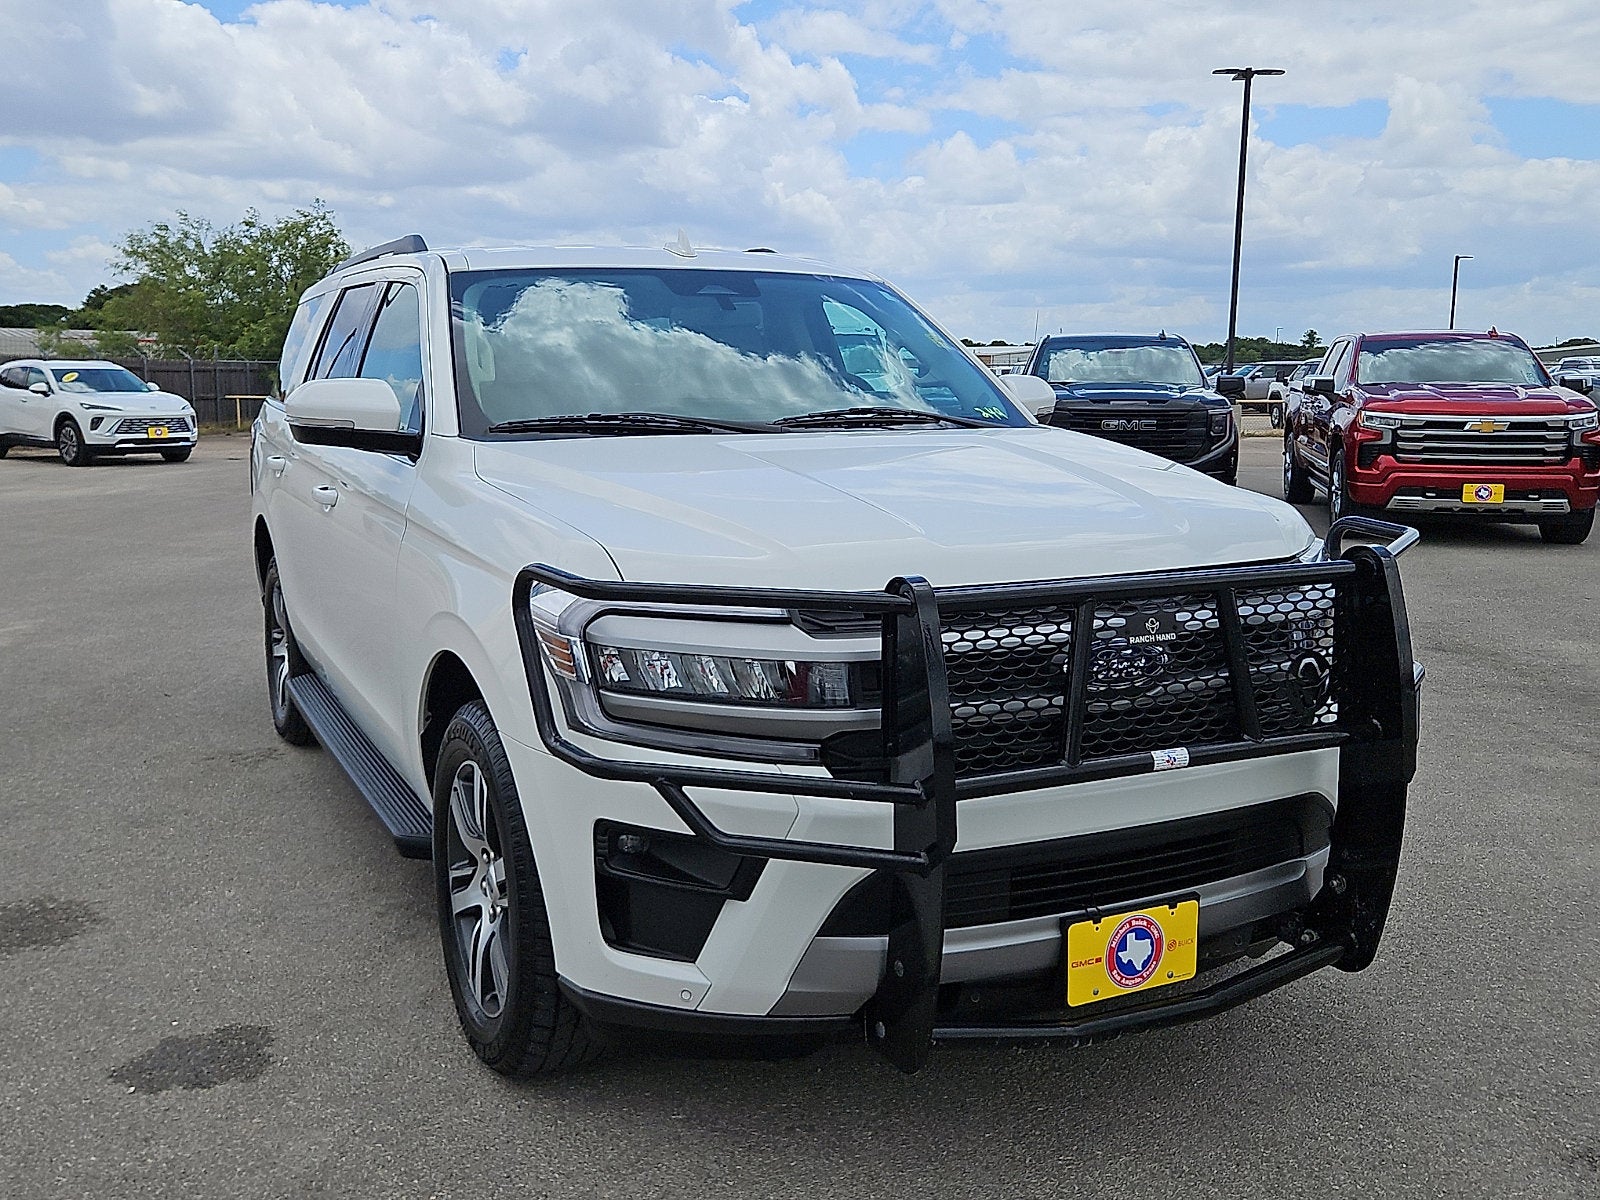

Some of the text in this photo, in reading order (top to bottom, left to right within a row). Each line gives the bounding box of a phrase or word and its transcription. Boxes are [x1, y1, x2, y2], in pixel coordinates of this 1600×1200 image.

[1101, 420, 1157, 431] GMC
[1129, 632, 1176, 644] RANCH HAND
[1071, 958, 1094, 968] GMC
